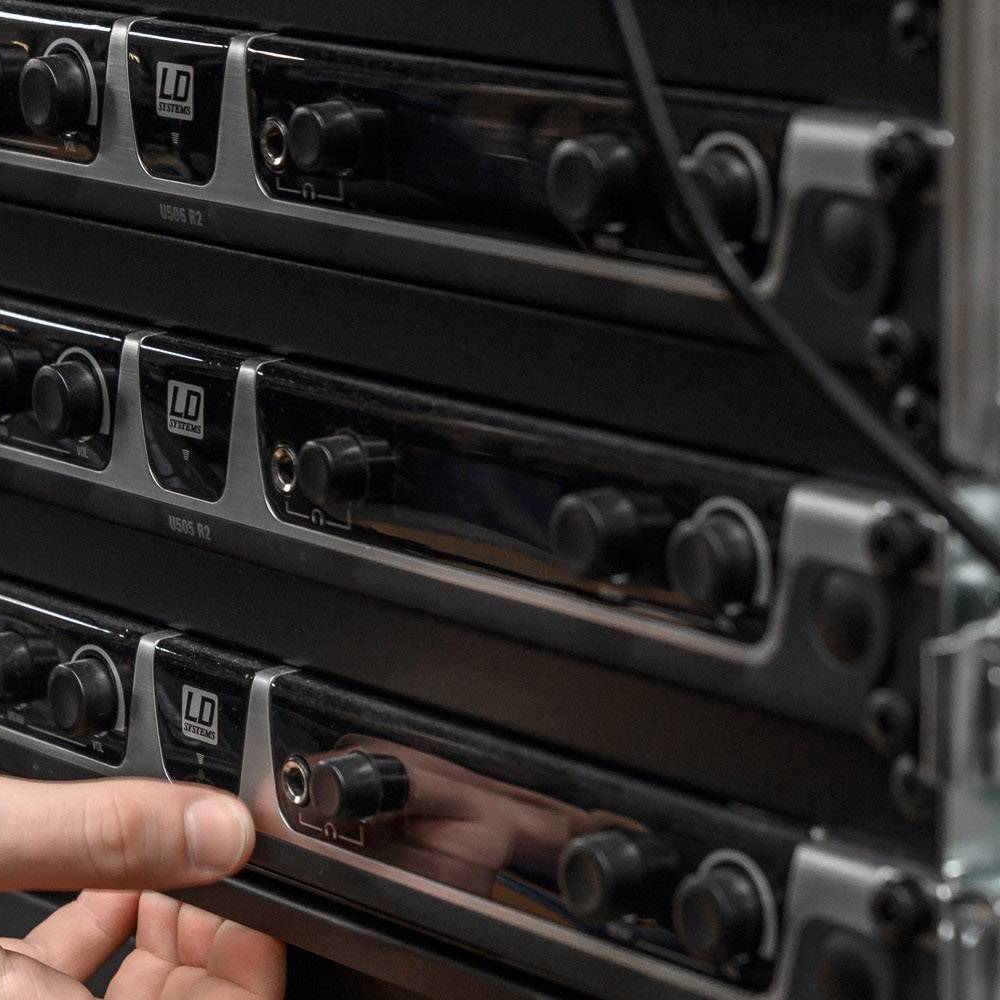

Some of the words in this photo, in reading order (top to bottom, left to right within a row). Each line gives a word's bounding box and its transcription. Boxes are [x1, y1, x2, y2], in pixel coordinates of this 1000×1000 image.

[160, 66, 190, 102] LD
[158, 101, 191, 116] SYSTEMS
[188, 209, 204, 227] R2
[170, 385, 200, 422] LD
[168, 419, 202, 436] SYSTEMS
[197, 522, 212, 540] R2
[185, 691, 215, 727] LD
[183, 721, 217, 741] SYSTEMS
